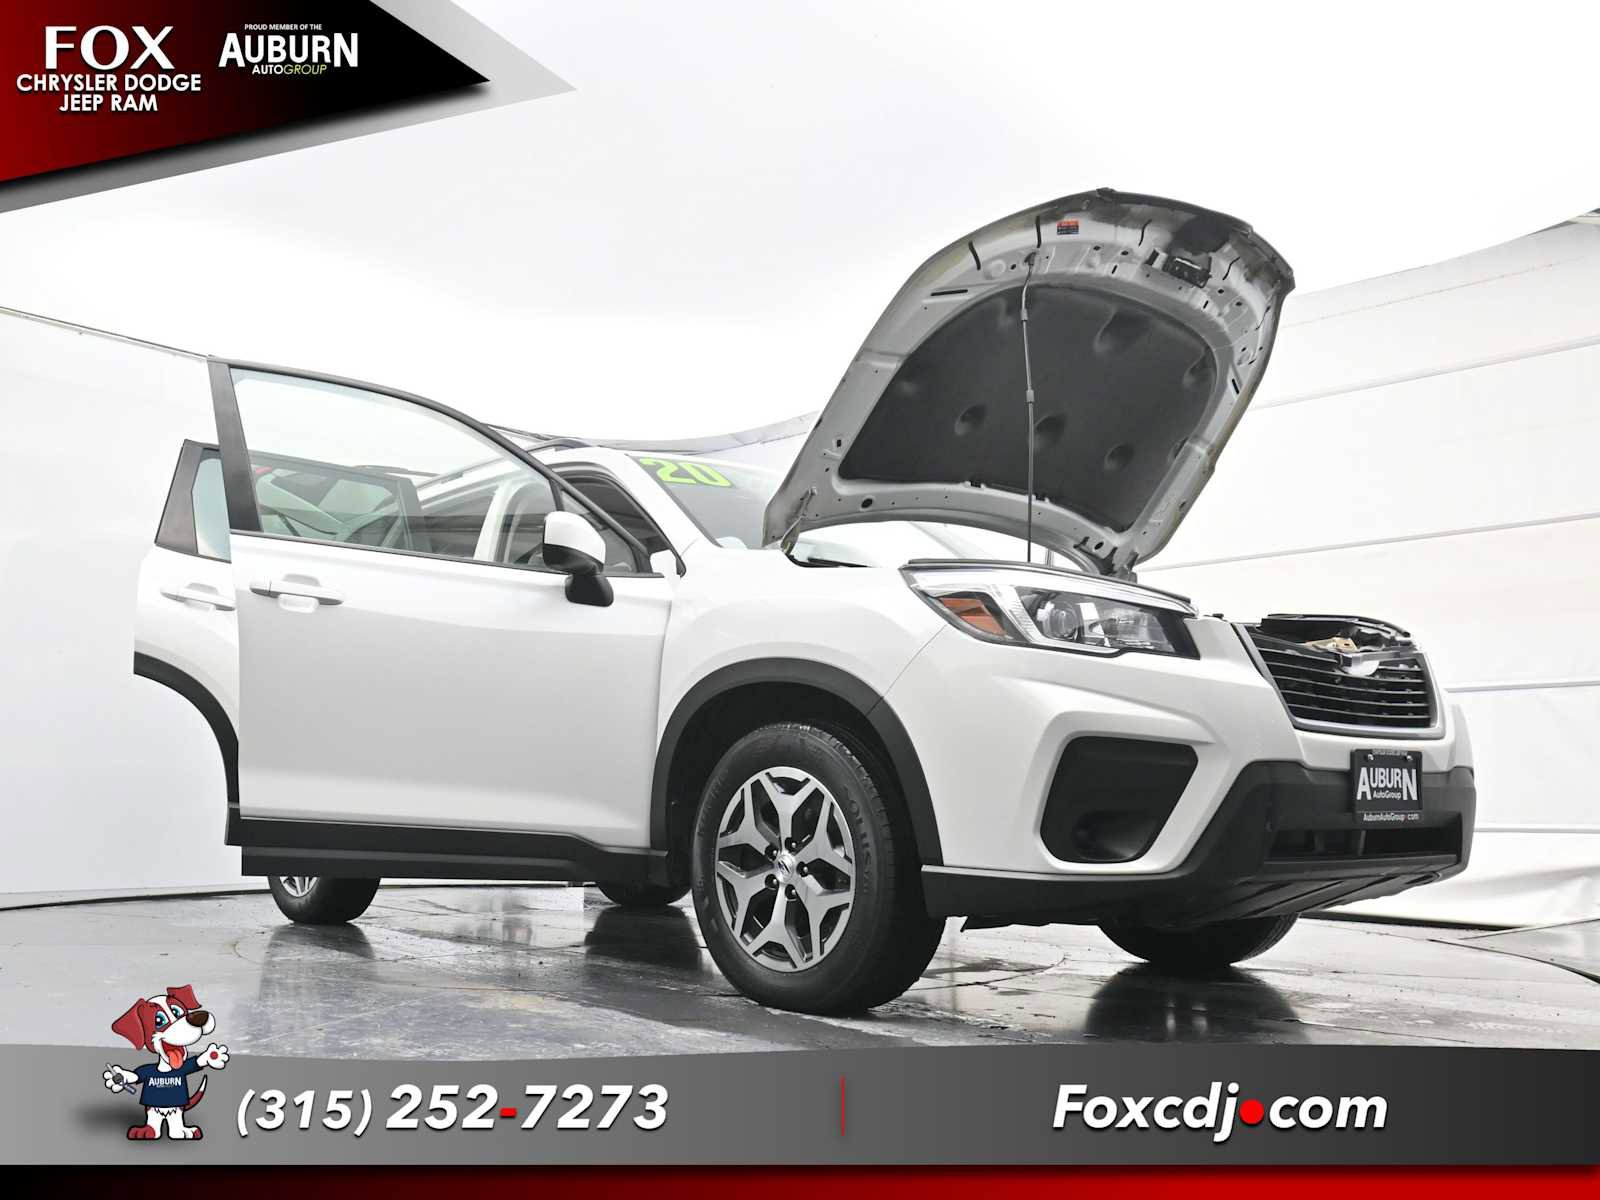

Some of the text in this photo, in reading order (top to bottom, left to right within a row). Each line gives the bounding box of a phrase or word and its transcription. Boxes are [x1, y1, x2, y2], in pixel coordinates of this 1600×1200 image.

[639, 457, 733, 488] 20
[1356, 767, 1418, 800] AUBURN
[1372, 791, 1402, 800] AutoGroup
